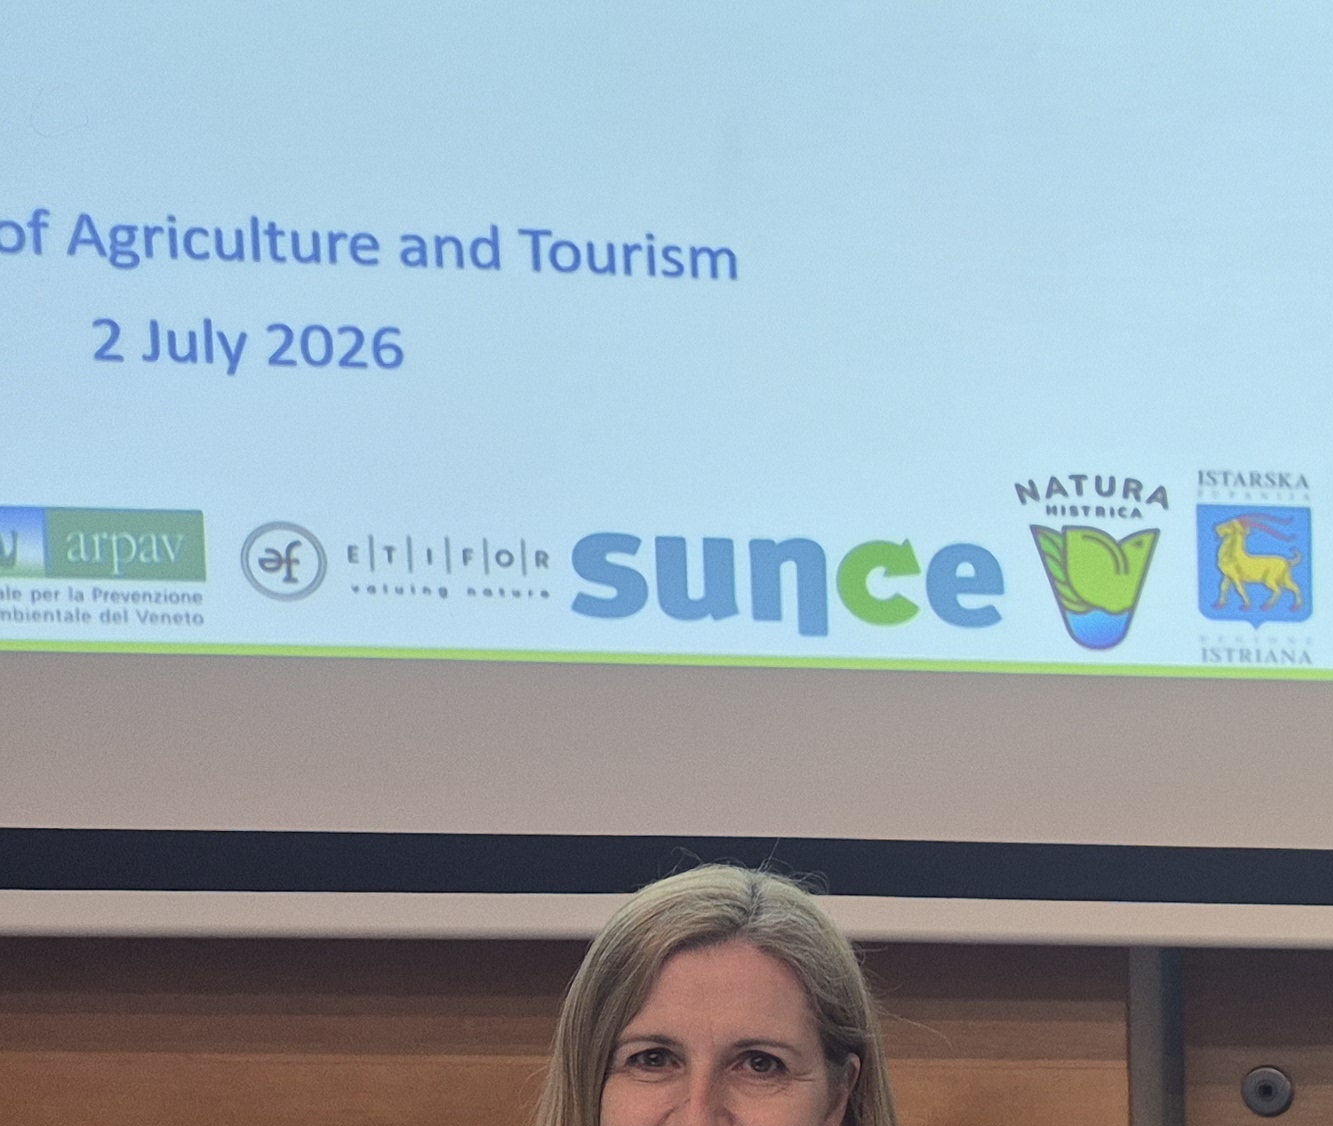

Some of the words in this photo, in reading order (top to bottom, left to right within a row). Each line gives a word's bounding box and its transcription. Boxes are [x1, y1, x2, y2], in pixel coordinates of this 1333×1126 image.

[66, 211, 381, 269] Agriculture
[399, 226, 502, 272] and
[517, 228, 739, 281] Tourism
[92, 318, 125, 364] 2
[142, 319, 248, 375] July
[266, 323, 405, 370] 2026
[1014, 474, 1170, 511] NATURA
[1199, 469, 1310, 490] ISTARSKA
[1046, 504, 1143, 519] HISTRICA
[66, 531, 186, 576] arpav
[31, 589, 60, 605] per
[68, 587, 84, 602] la
[92, 587, 203, 605] Prevenzione
[570, 529, 1004, 637] sunce
[99, 608, 128, 625] del
[136, 609, 205, 626] Veneto
[1201, 647, 1312, 666] ISTRIANA
